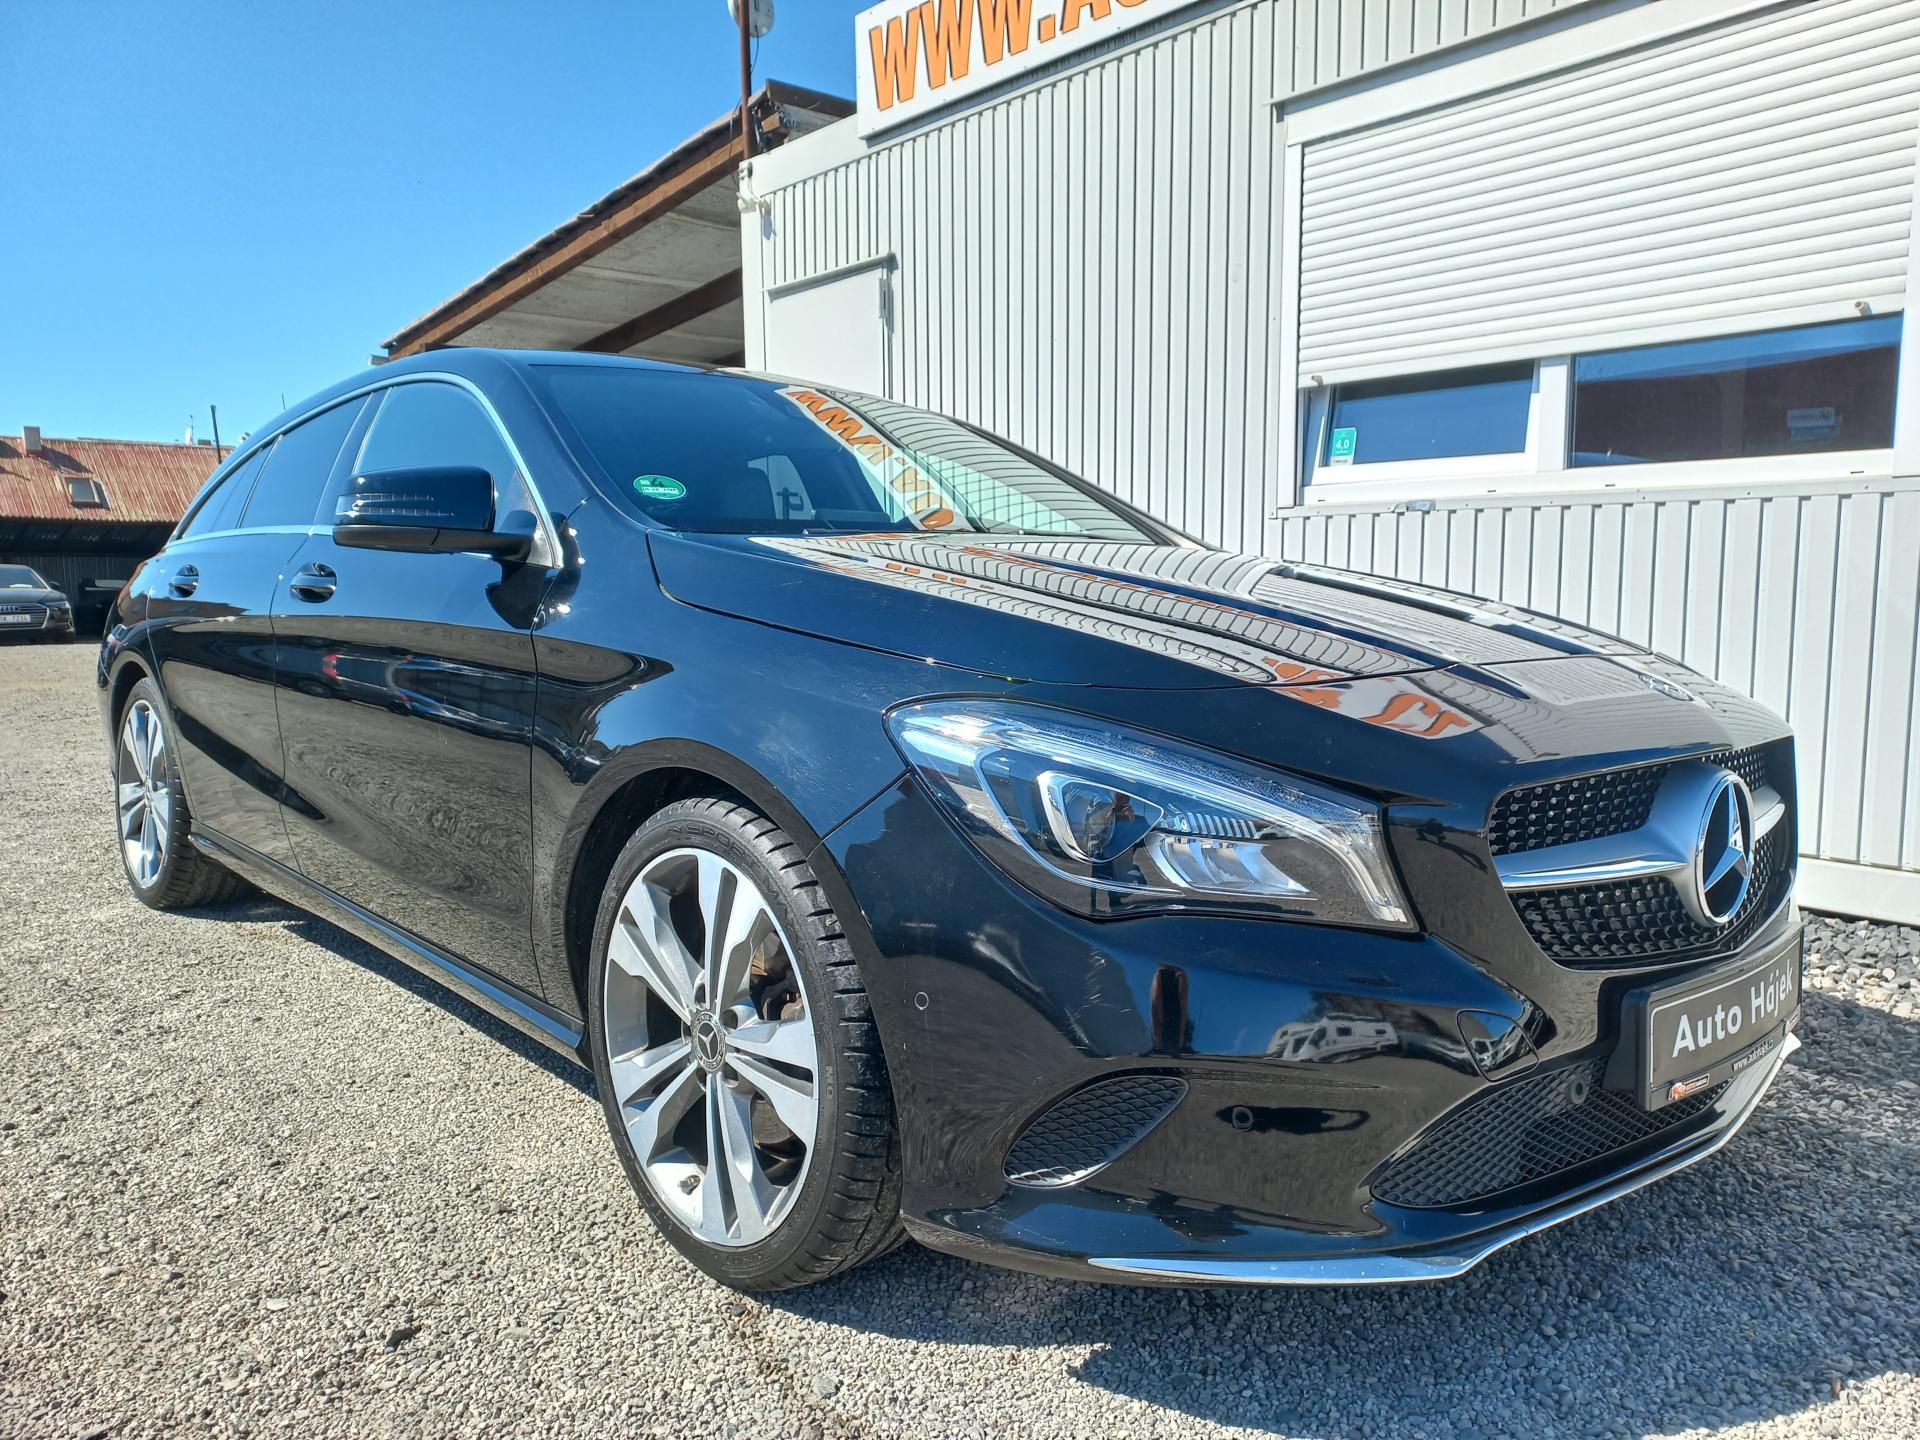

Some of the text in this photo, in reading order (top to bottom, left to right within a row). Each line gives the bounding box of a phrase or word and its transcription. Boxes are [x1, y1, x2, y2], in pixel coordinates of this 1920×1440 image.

[868, 0, 1147, 112] WWW.
[1671, 959, 1793, 1059] Auto Hájek
